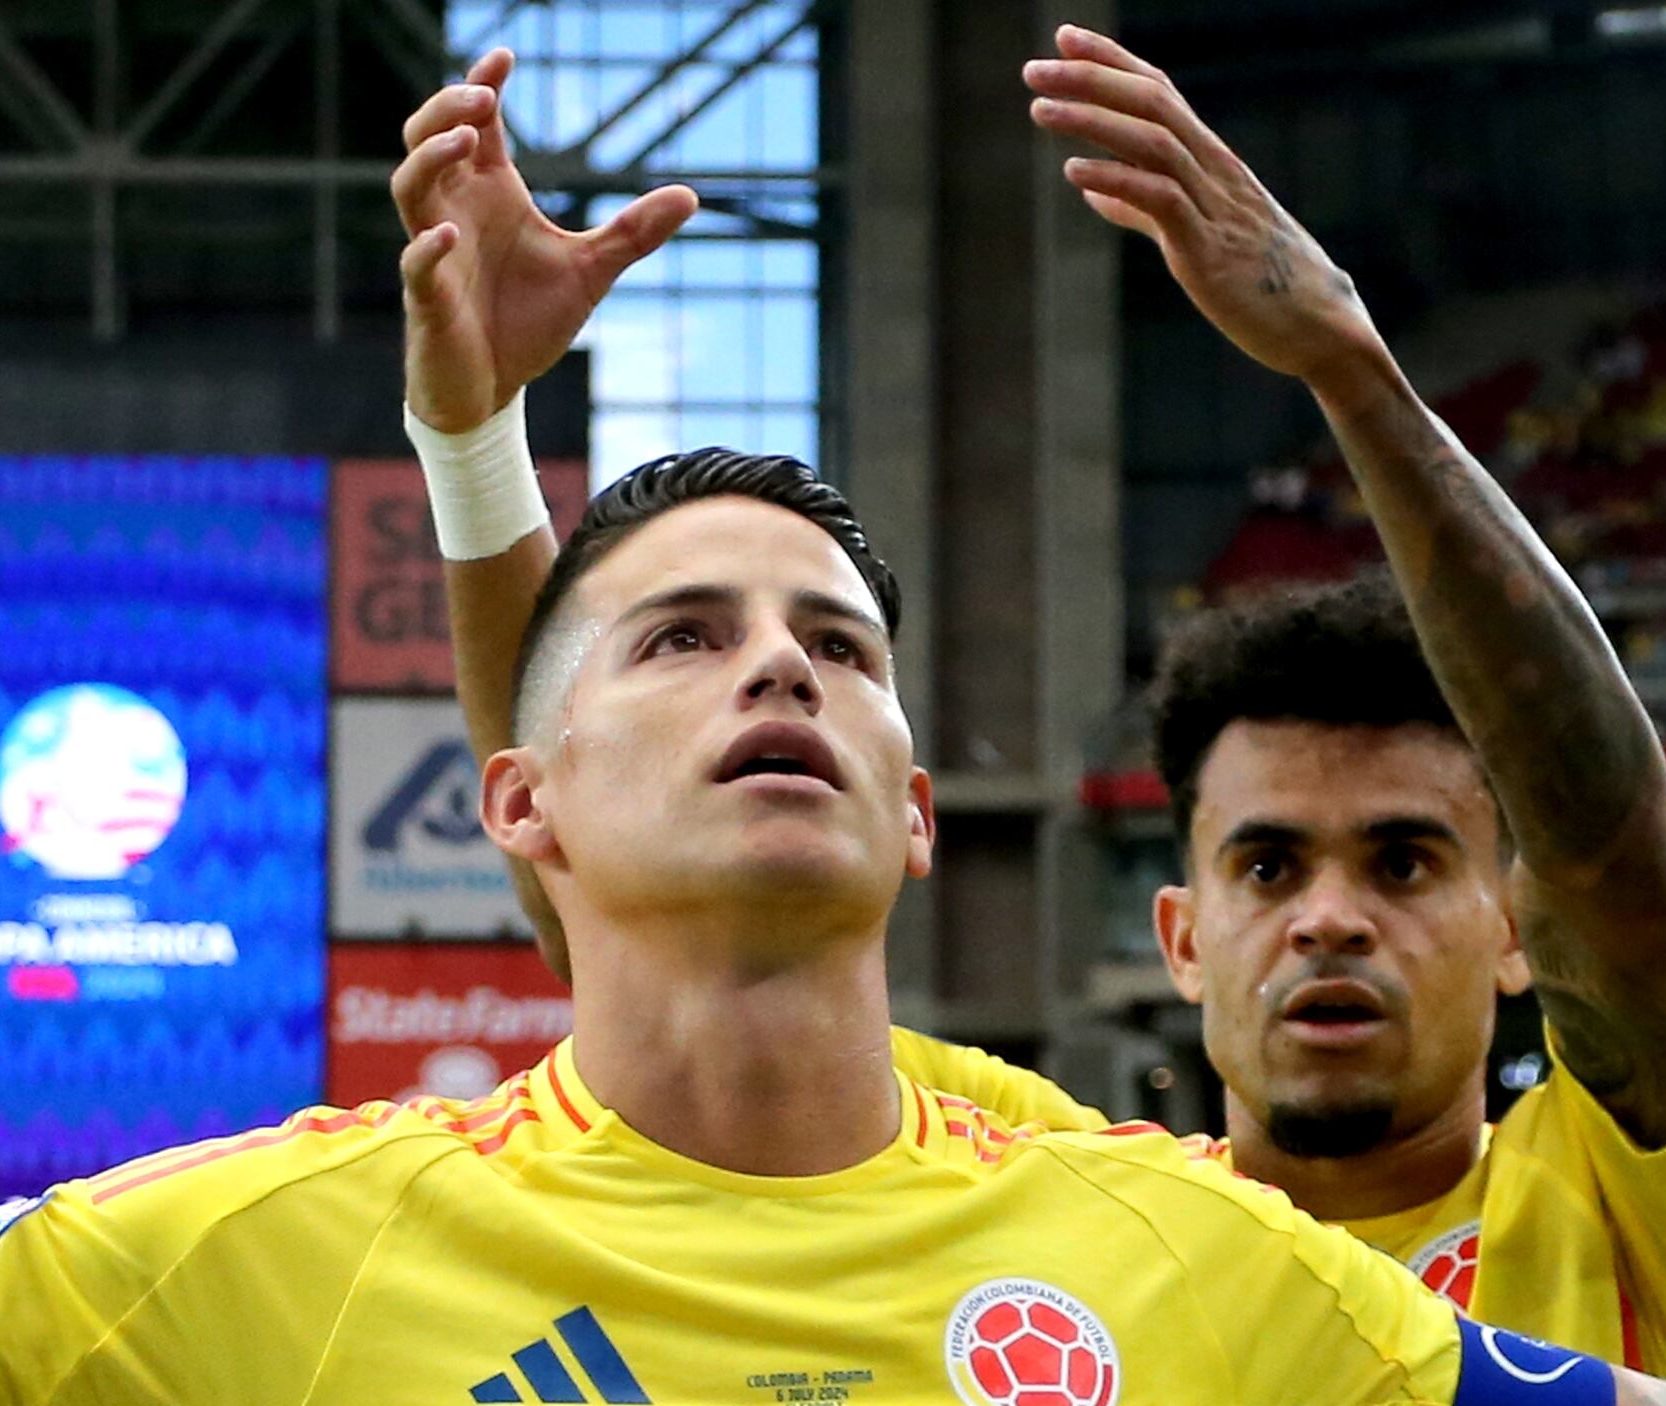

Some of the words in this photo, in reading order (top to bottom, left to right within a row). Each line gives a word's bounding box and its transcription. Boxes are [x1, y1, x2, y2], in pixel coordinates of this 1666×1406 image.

[747, 1372, 808, 1388] COLOMBIA
[776, 1388, 784, 1402] 6
[788, 1388, 814, 1402] JULY
[819, 1386, 849, 1401] 2024
